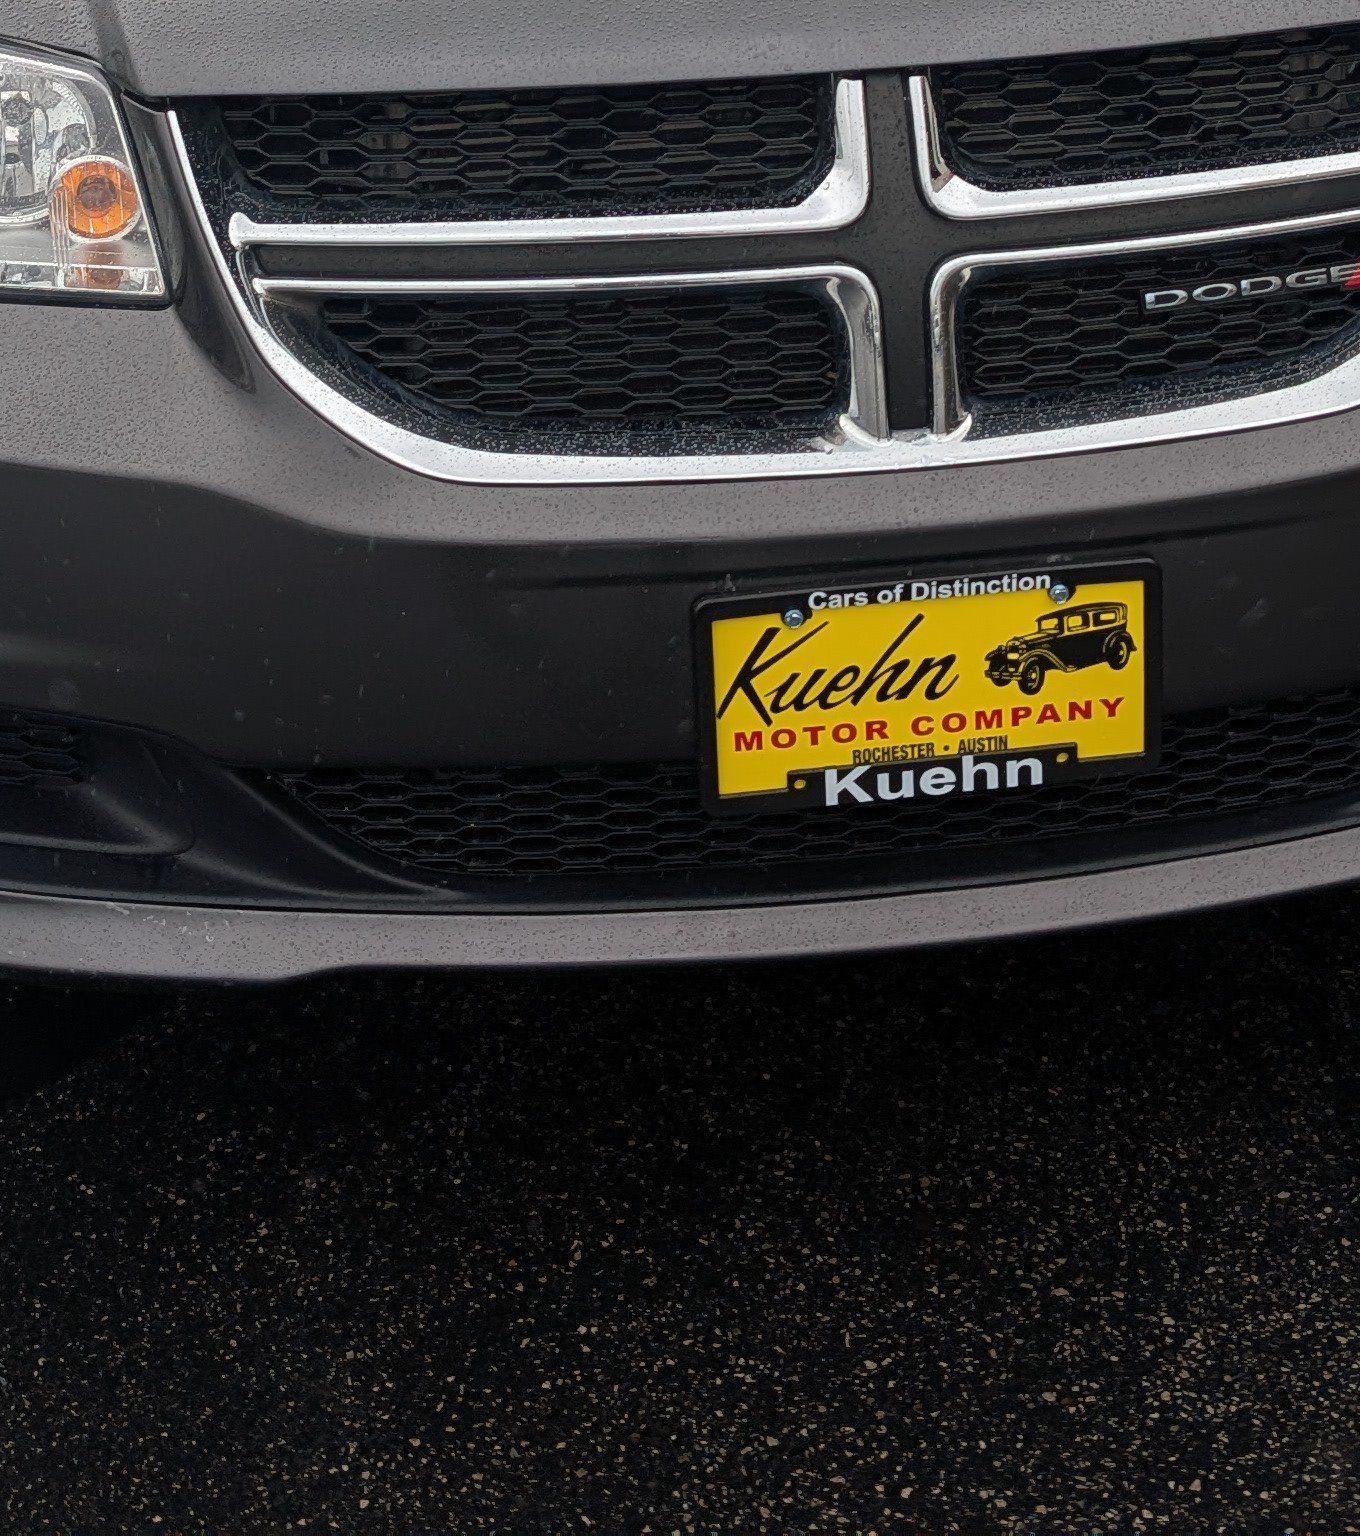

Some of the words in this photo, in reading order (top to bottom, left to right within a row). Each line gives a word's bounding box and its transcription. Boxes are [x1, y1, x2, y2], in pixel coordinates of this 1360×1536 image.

[808, 589, 870, 612] Cars
[876, 583, 907, 605] of
[911, 571, 1052, 602] Distinction
[716, 613, 960, 727] Kuehn
[734, 720, 889, 752] MOTOR
[911, 697, 1126, 736] COMPANY
[851, 741, 936, 763] ROCHESTER
[957, 734, 1009, 754] AUSTIN
[824, 754, 1044, 807] Kuehn
